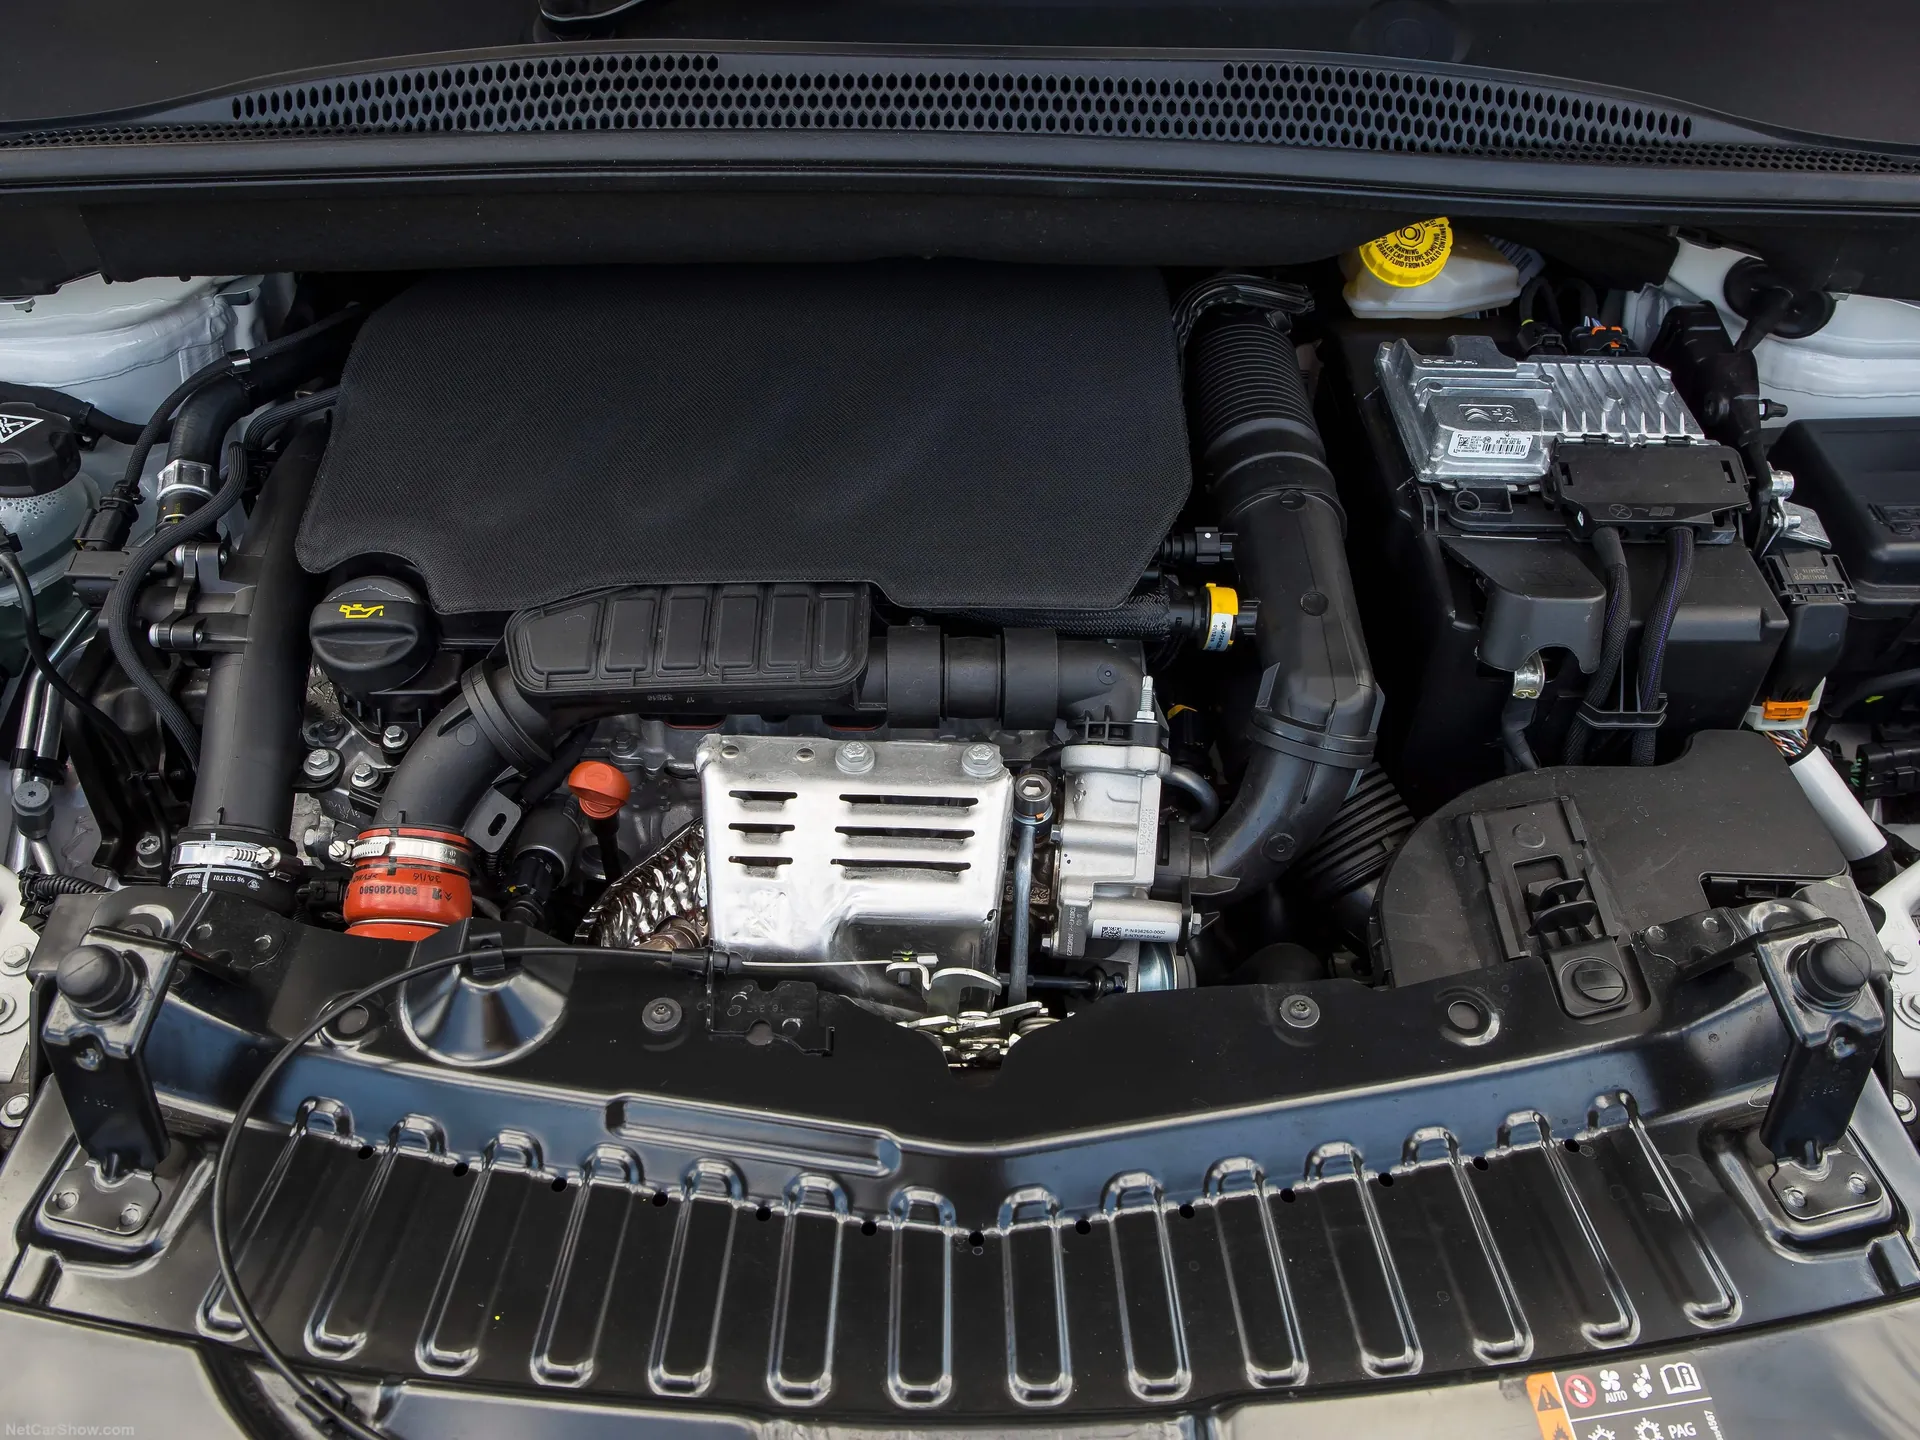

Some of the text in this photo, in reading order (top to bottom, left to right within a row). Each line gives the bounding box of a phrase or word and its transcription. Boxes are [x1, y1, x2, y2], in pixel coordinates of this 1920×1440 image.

[1376, 243, 1391, 259] BRAKE
[1389, 256, 1405, 268] FLUID
[1425, 251, 1442, 266] SEALED
[1438, 224, 1447, 252] CONTAINER
[1393, 248, 1405, 260] CAP
[1404, 253, 1425, 262] BEFORE
[1425, 233, 1440, 258] REMOVING
[1394, 243, 1420, 256] WARNING
[1605, 1390, 1628, 1403] AUTO
[1667, 1422, 1697, 1439] PAG
